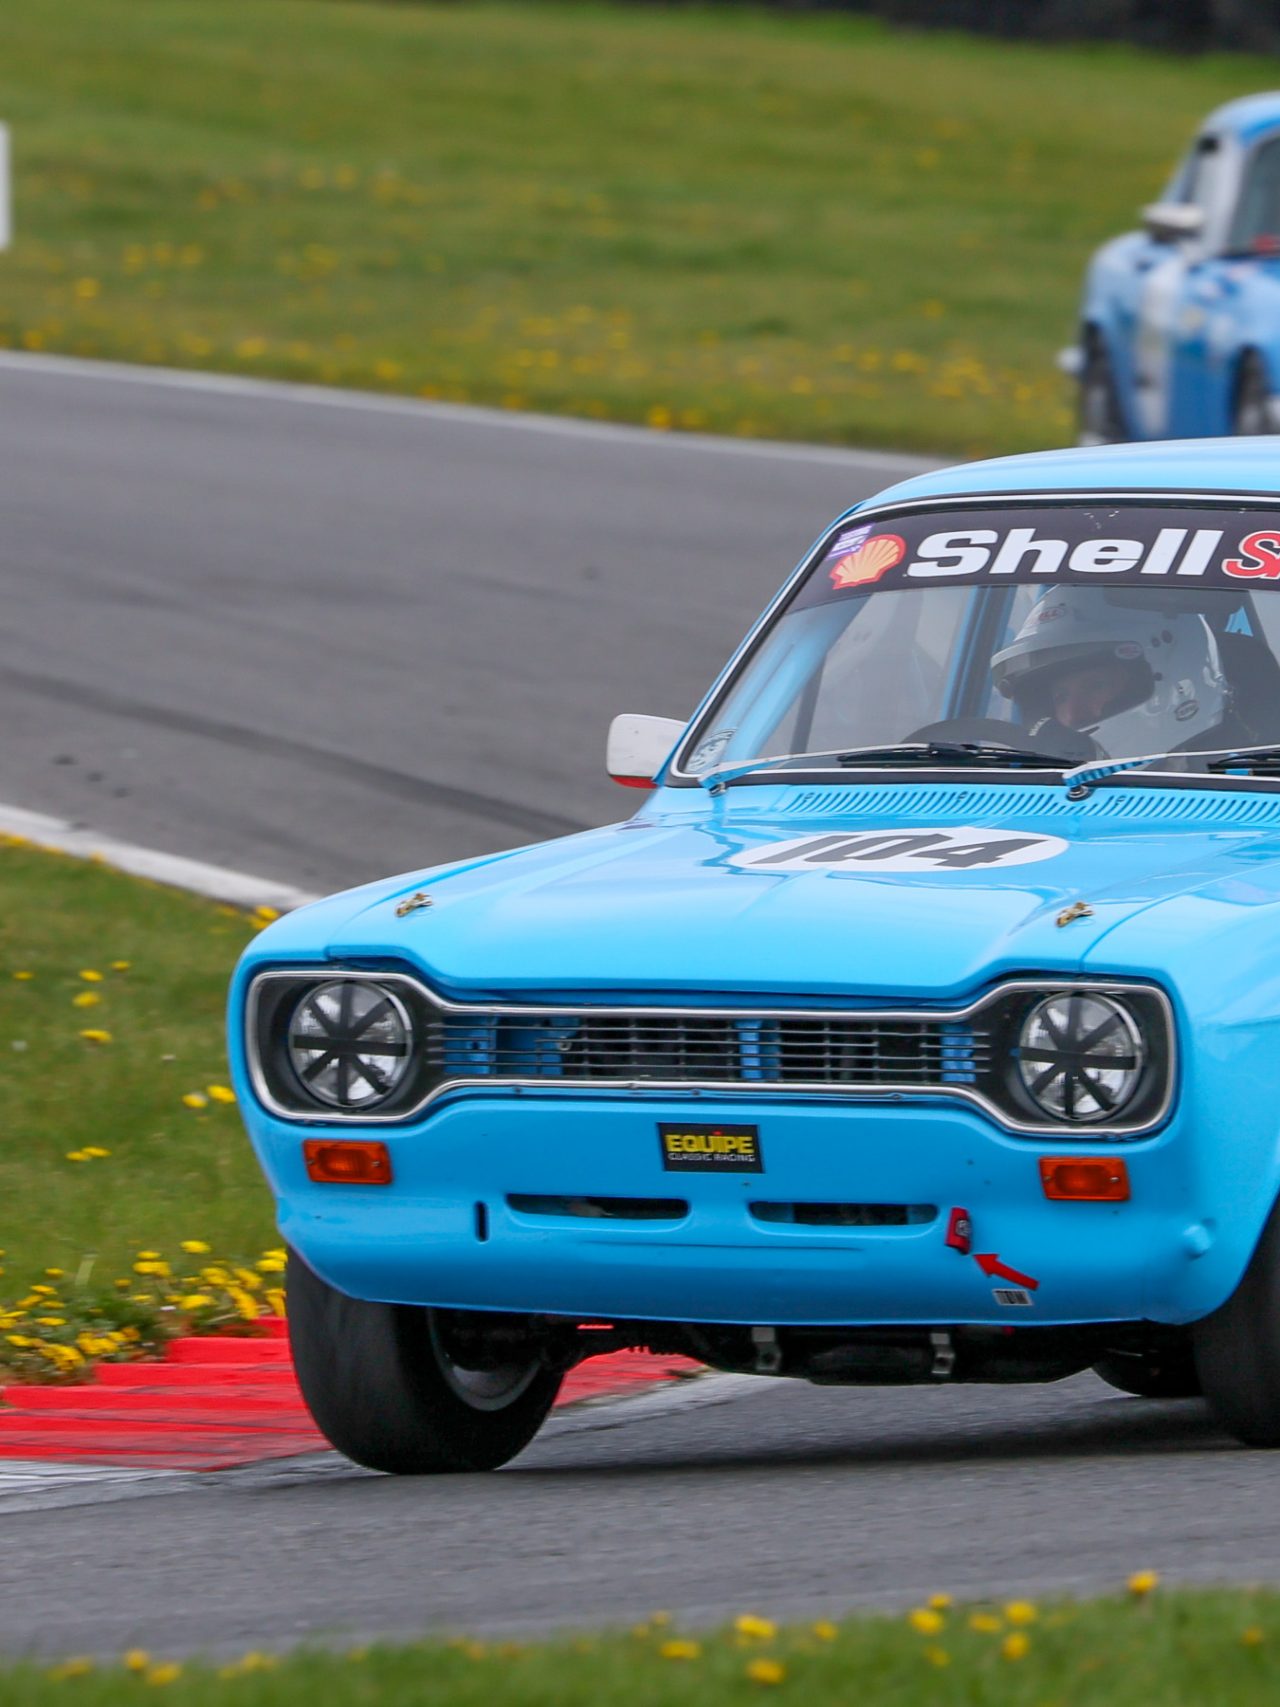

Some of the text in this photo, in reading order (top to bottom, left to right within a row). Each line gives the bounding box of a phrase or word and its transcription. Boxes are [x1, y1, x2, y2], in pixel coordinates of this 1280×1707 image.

[907, 528, 1224, 577] Shell
[749, 833, 1049, 868] 104
[665, 1132, 755, 1153] EQUIPE
[714, 1153, 756, 1162] RACING
